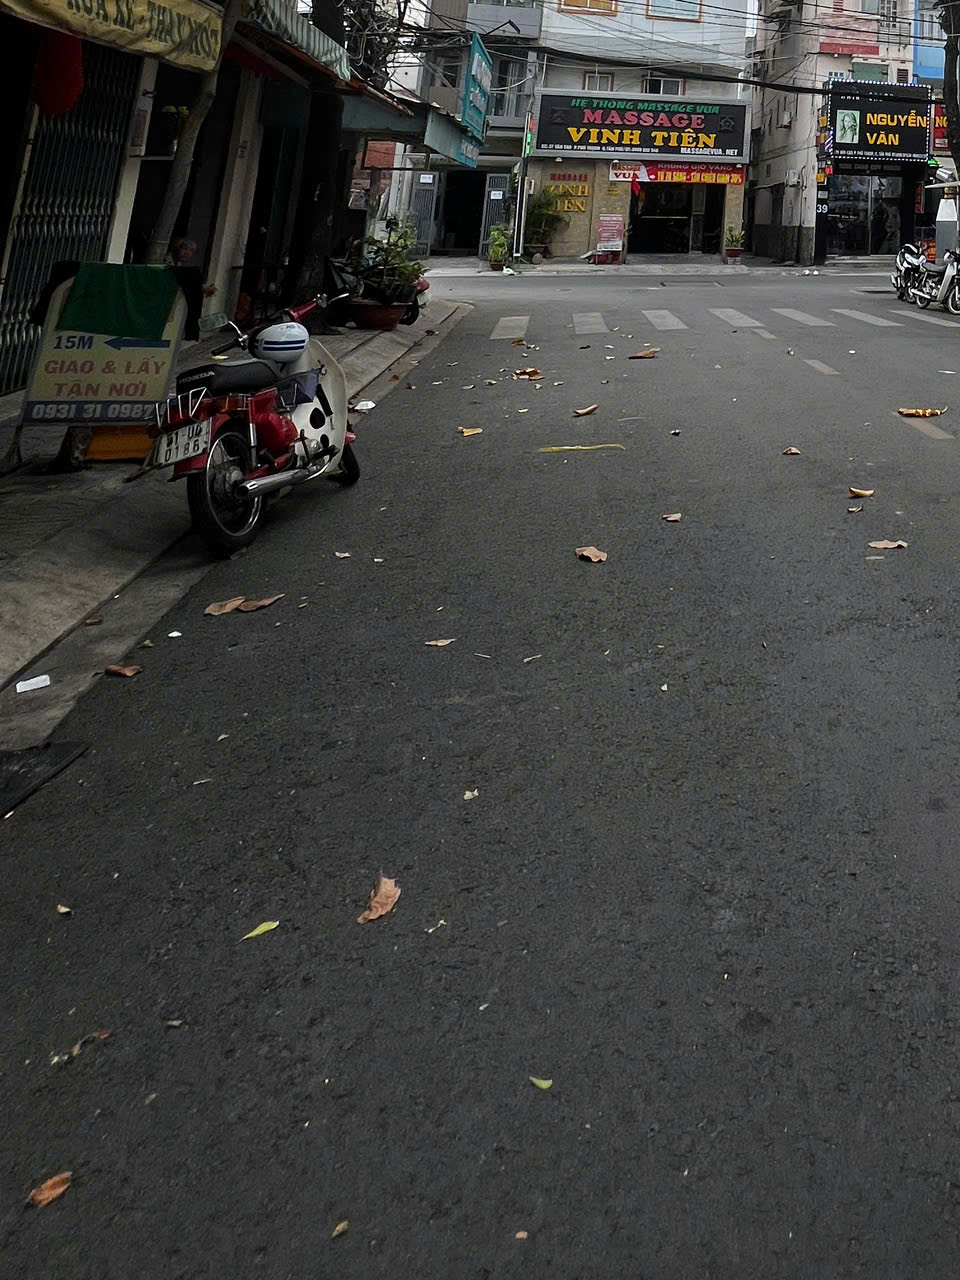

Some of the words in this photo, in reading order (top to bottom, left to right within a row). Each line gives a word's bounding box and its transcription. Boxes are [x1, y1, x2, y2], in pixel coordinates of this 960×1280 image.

[637, 102, 694, 113] MASSAGE
[696, 105, 721, 114] VUA
[583, 109, 705, 129] MASSAGE
[866, 110, 927, 127] NGUYỄN
[567, 127, 641, 145] VINH
[651, 127, 716, 148] TIÊN
[866, 131, 899, 145] VĂN
[816, 204, 828, 213] 39
[53, 335, 94, 350] 15M
[44, 359, 95, 375] GIAO
[101, 361, 116, 375] &
[124, 355, 166, 376] LẤY
[32, 404, 77, 419] 0931
[82, 404, 103, 419] 31
